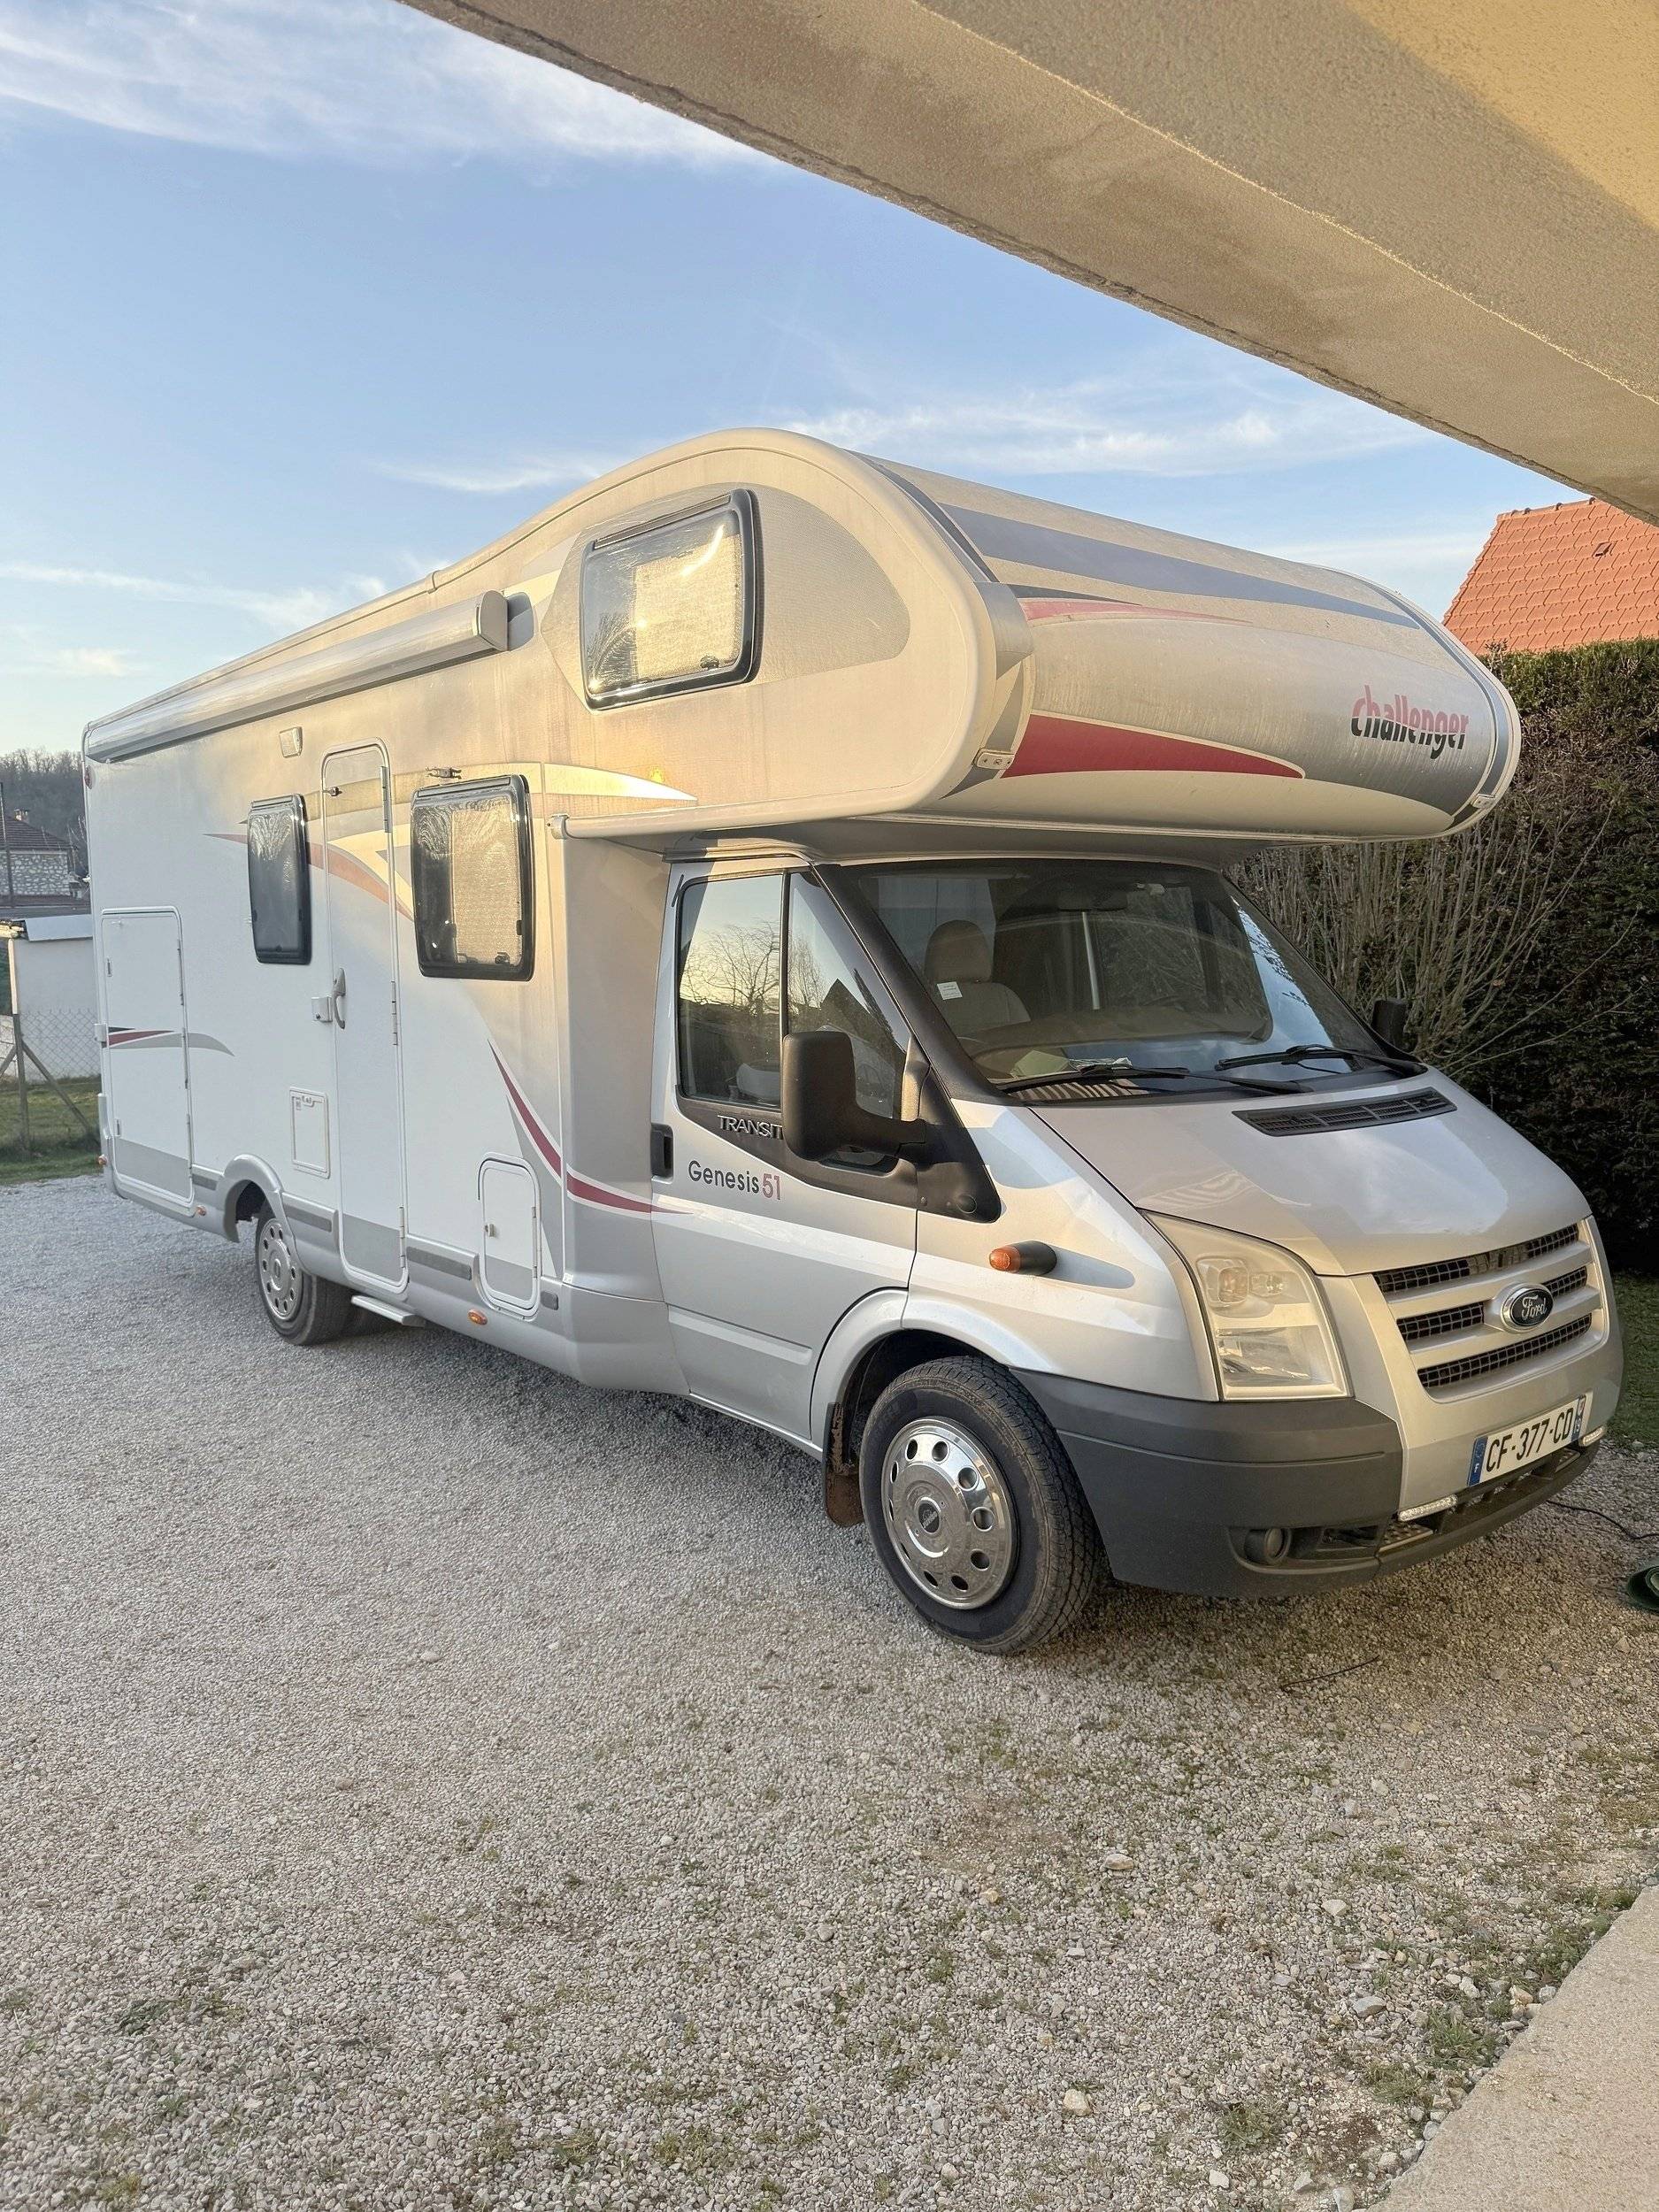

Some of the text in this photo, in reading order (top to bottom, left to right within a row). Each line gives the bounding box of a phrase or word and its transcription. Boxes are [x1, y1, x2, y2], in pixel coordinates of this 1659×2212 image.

[1350, 685, 1470, 759] challenger
[1522, 1294, 1547, 1320] Ford
[1486, 1407, 1574, 1472] CF-377-CD
